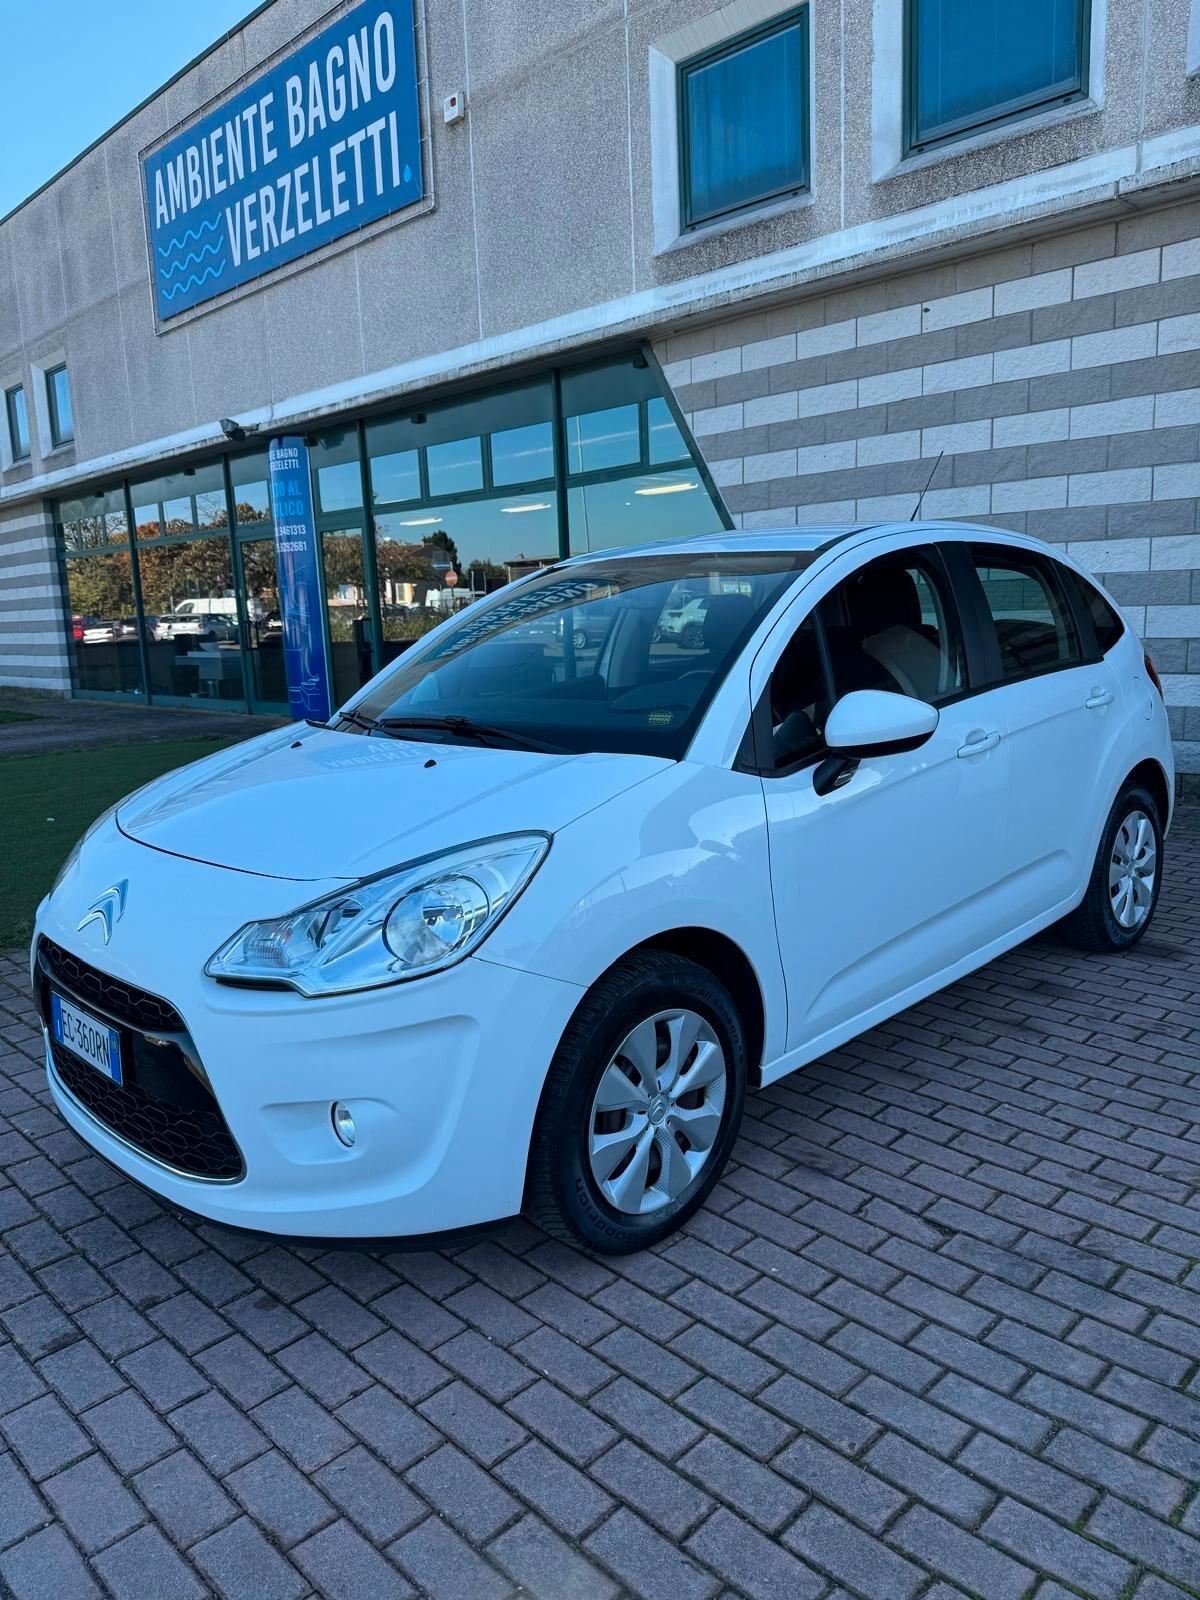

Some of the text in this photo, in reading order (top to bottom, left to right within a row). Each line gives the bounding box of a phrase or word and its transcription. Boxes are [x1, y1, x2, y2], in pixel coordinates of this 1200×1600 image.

[154, 11, 397, 230] AMBIENTE BAGNO
[225, 111, 401, 268] VERZELETTI
[276, 447, 298, 459] BAGNO
[288, 480, 302, 496] AL
[61, 1008, 75, 1042] EC
[75, 1018, 111, 1069] 360RN
